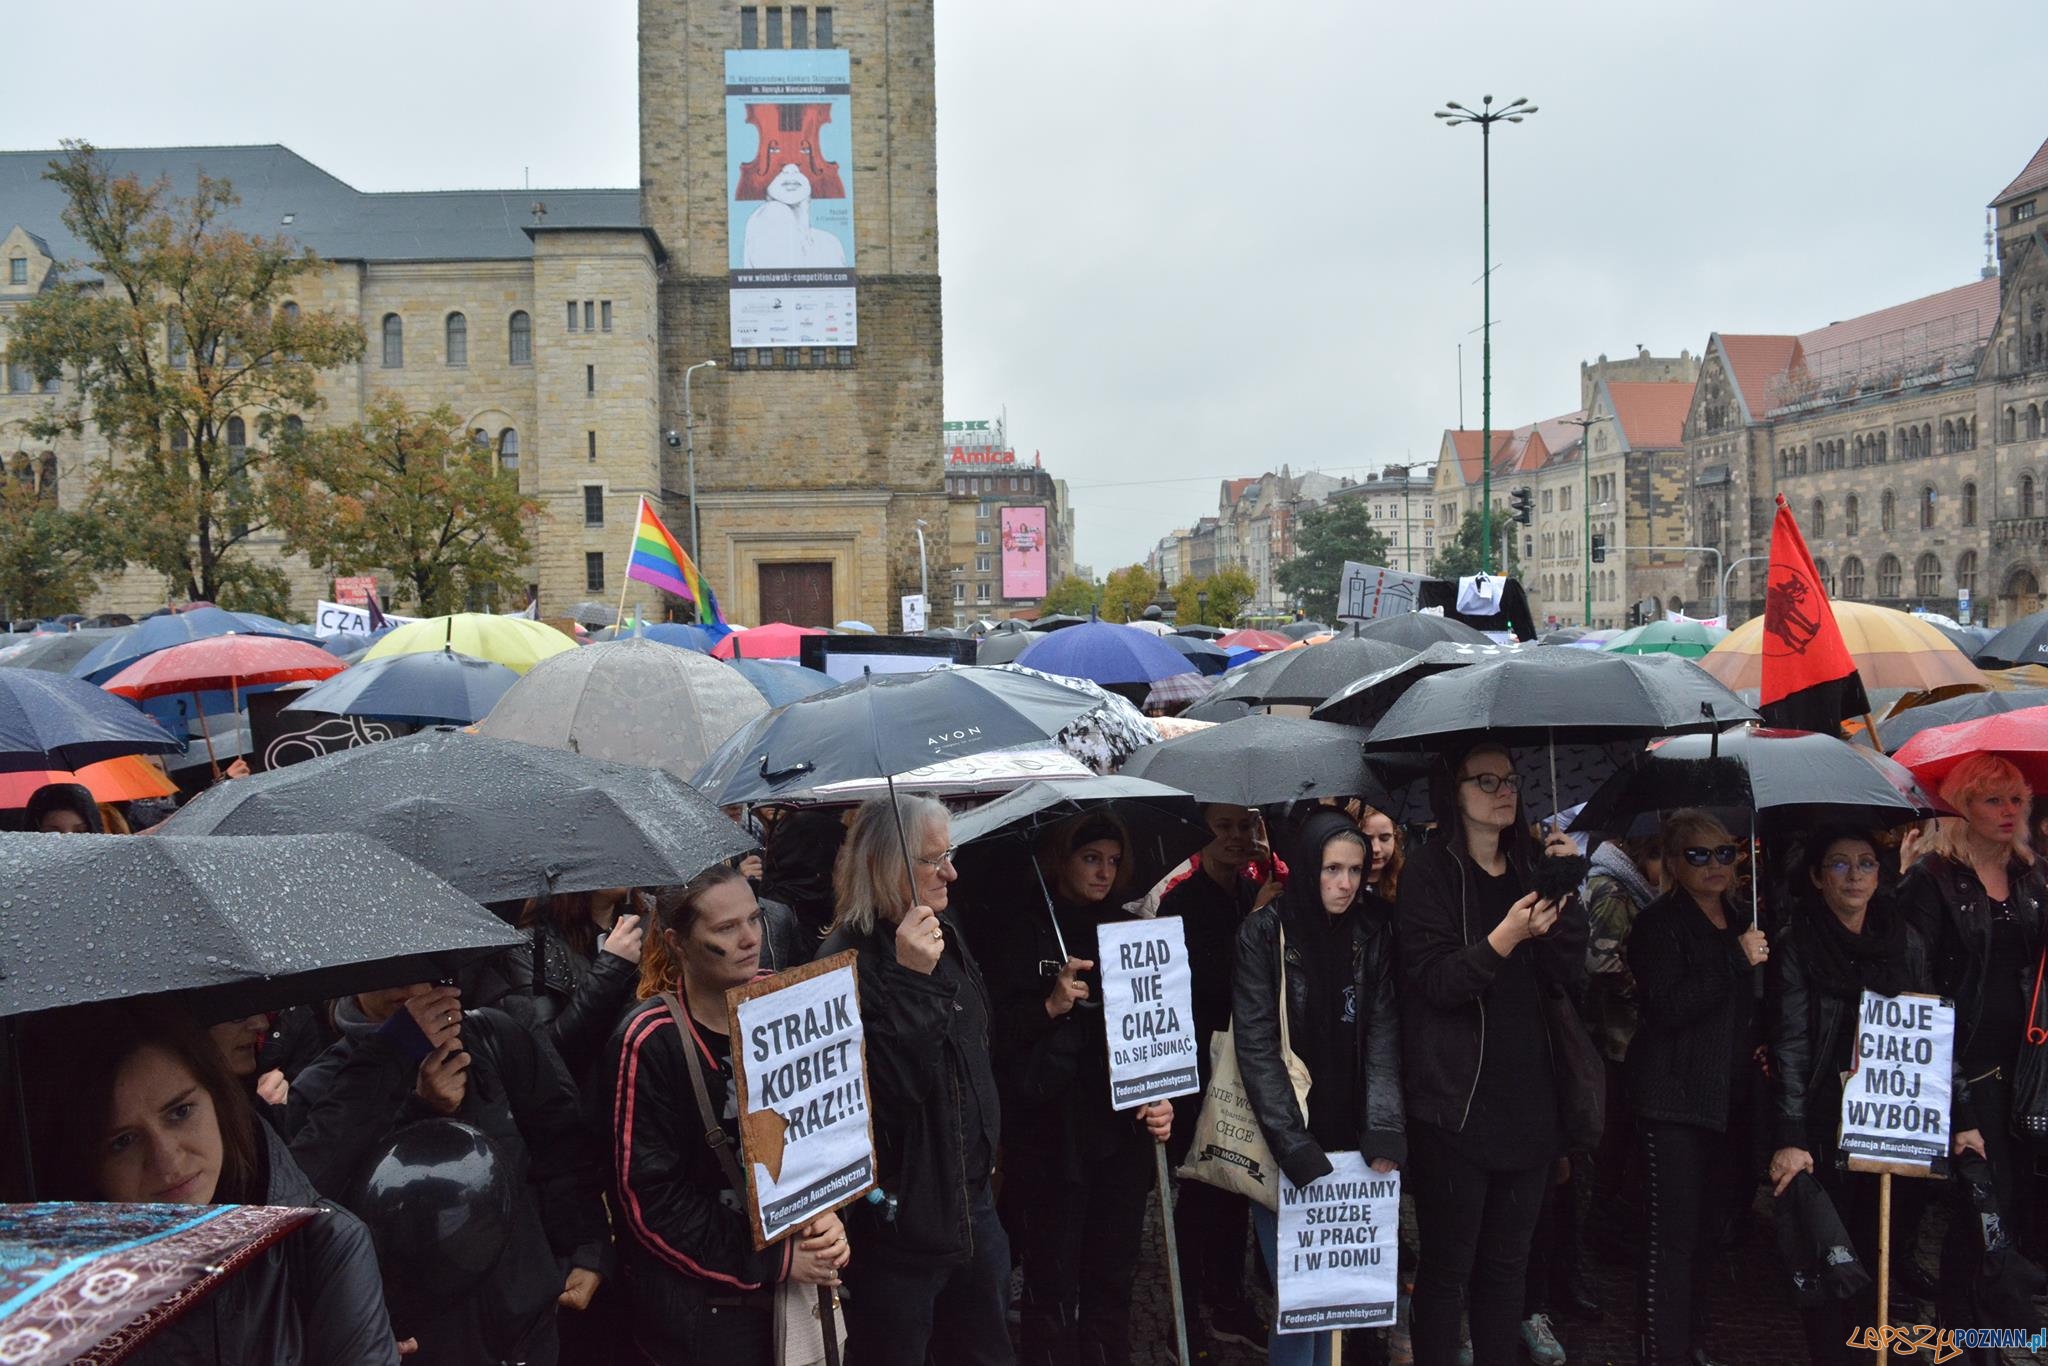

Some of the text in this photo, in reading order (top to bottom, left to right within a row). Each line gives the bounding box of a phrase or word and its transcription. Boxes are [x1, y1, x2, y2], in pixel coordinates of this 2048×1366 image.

[951, 445, 1015, 465] Amica
[928, 726, 982, 746] AVON
[1120, 939, 1170, 972] RZĄD
[1130, 974, 1163, 1004] NIE
[751, 994, 854, 1062] STRAJK
[1122, 1002, 1180, 1042] CIĄŻA
[1864, 999, 1933, 1031] MOJE
[1114, 1034, 1193, 1066] DA SIĘ USUNĄĆ
[1859, 1032, 1933, 1065] CIAŁO
[761, 1039, 852, 1108] KOBIET
[1116, 1074, 1192, 1097] Federacja Anarchistyczna
[1865, 1064, 1921, 1099] MÓJ
[1210, 1086, 1233, 1104] NIE
[784, 1078, 865, 1146] RAZ!!!
[1847, 1099, 1941, 1135] WYBÓR
[1216, 1119, 1255, 1143] CHCE
[1843, 1138, 1938, 1156] Federacja Anarchistyczna
[769, 1166, 867, 1223] Federacja Anarchistyczna
[1283, 1180, 1397, 1206] WYMAWIAMY
[1306, 1201, 1372, 1226] SŁUŻBĘ
[1297, 1226, 1378, 1248] W PRACY
[1294, 1247, 1381, 1272] I W DOMU
[1285, 1307, 1387, 1324] Federacja Anarchistyczna
